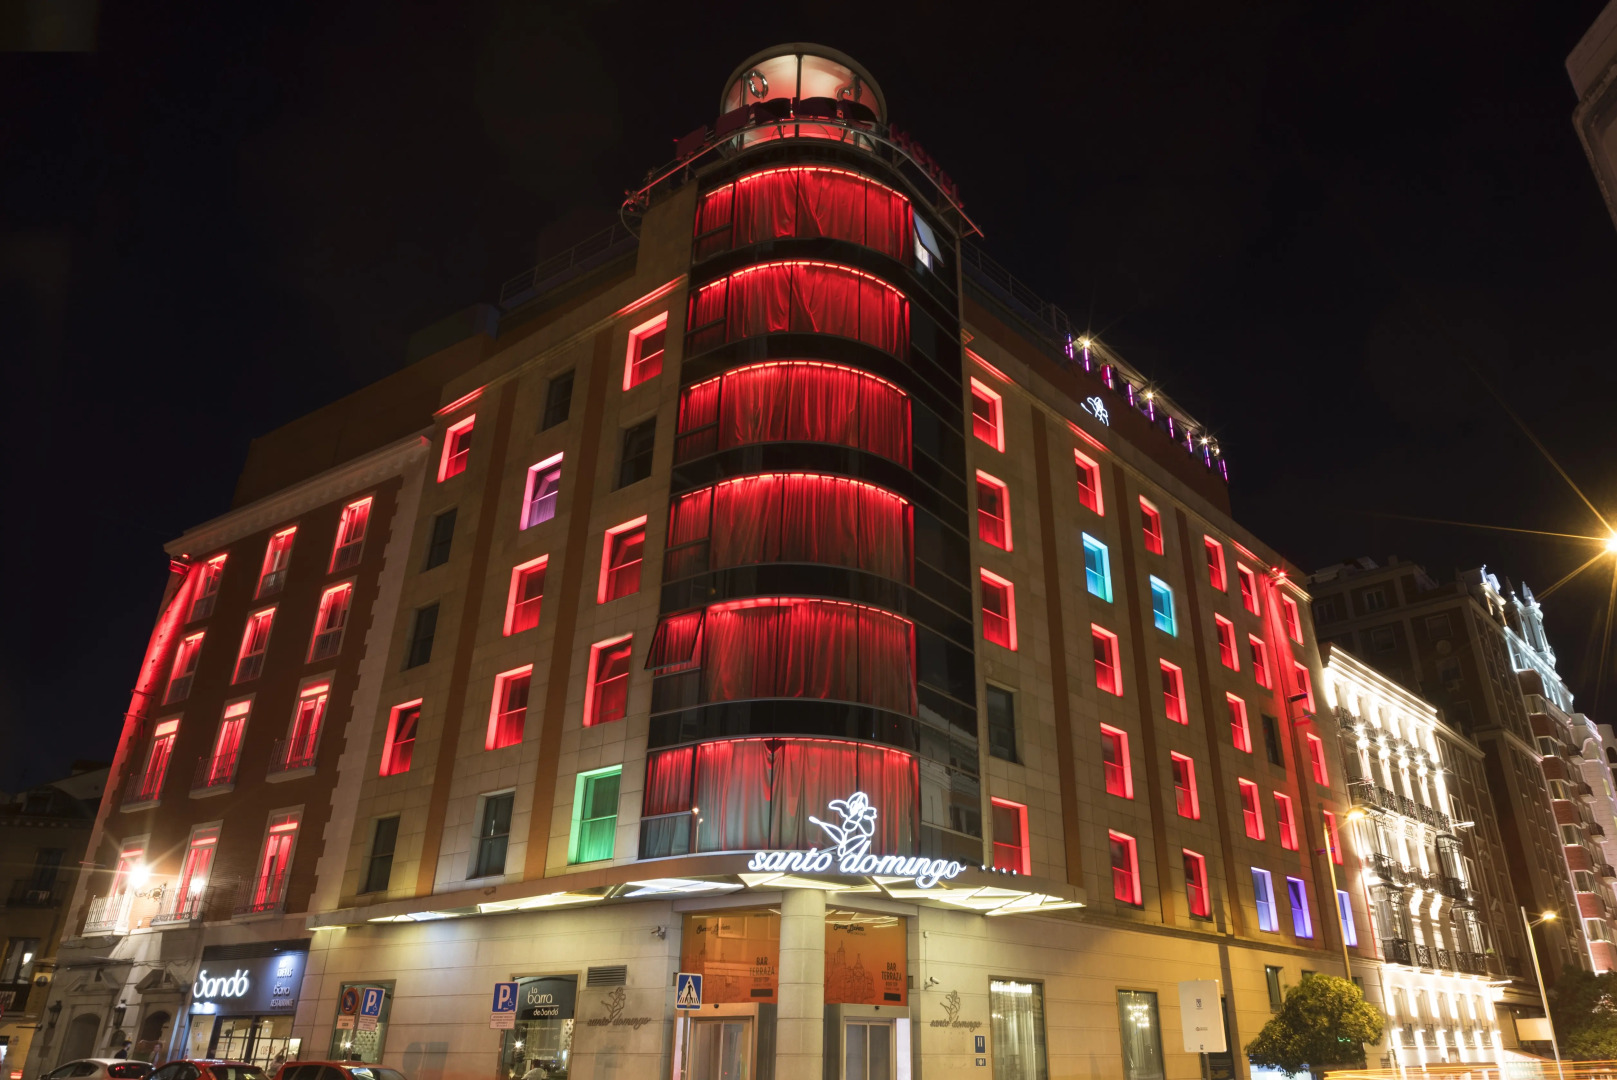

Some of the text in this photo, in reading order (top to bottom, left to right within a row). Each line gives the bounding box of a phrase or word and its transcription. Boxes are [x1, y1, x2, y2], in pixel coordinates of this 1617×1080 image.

[748, 840, 967, 889] santo domingo
[755, 956, 769, 966] BAR
[886, 962, 897, 971] BAR
[749, 966, 775, 977] TERRAZA
[881, 971, 902, 981] TERRAZA
[194, 969, 248, 998] Sandó
[365, 990, 377, 1013] P
[497, 985, 511, 1010] P
[527, 991, 553, 1005] barra
[587, 1012, 652, 1030] santo domingo
[930, 1015, 982, 1032] santo domingo
